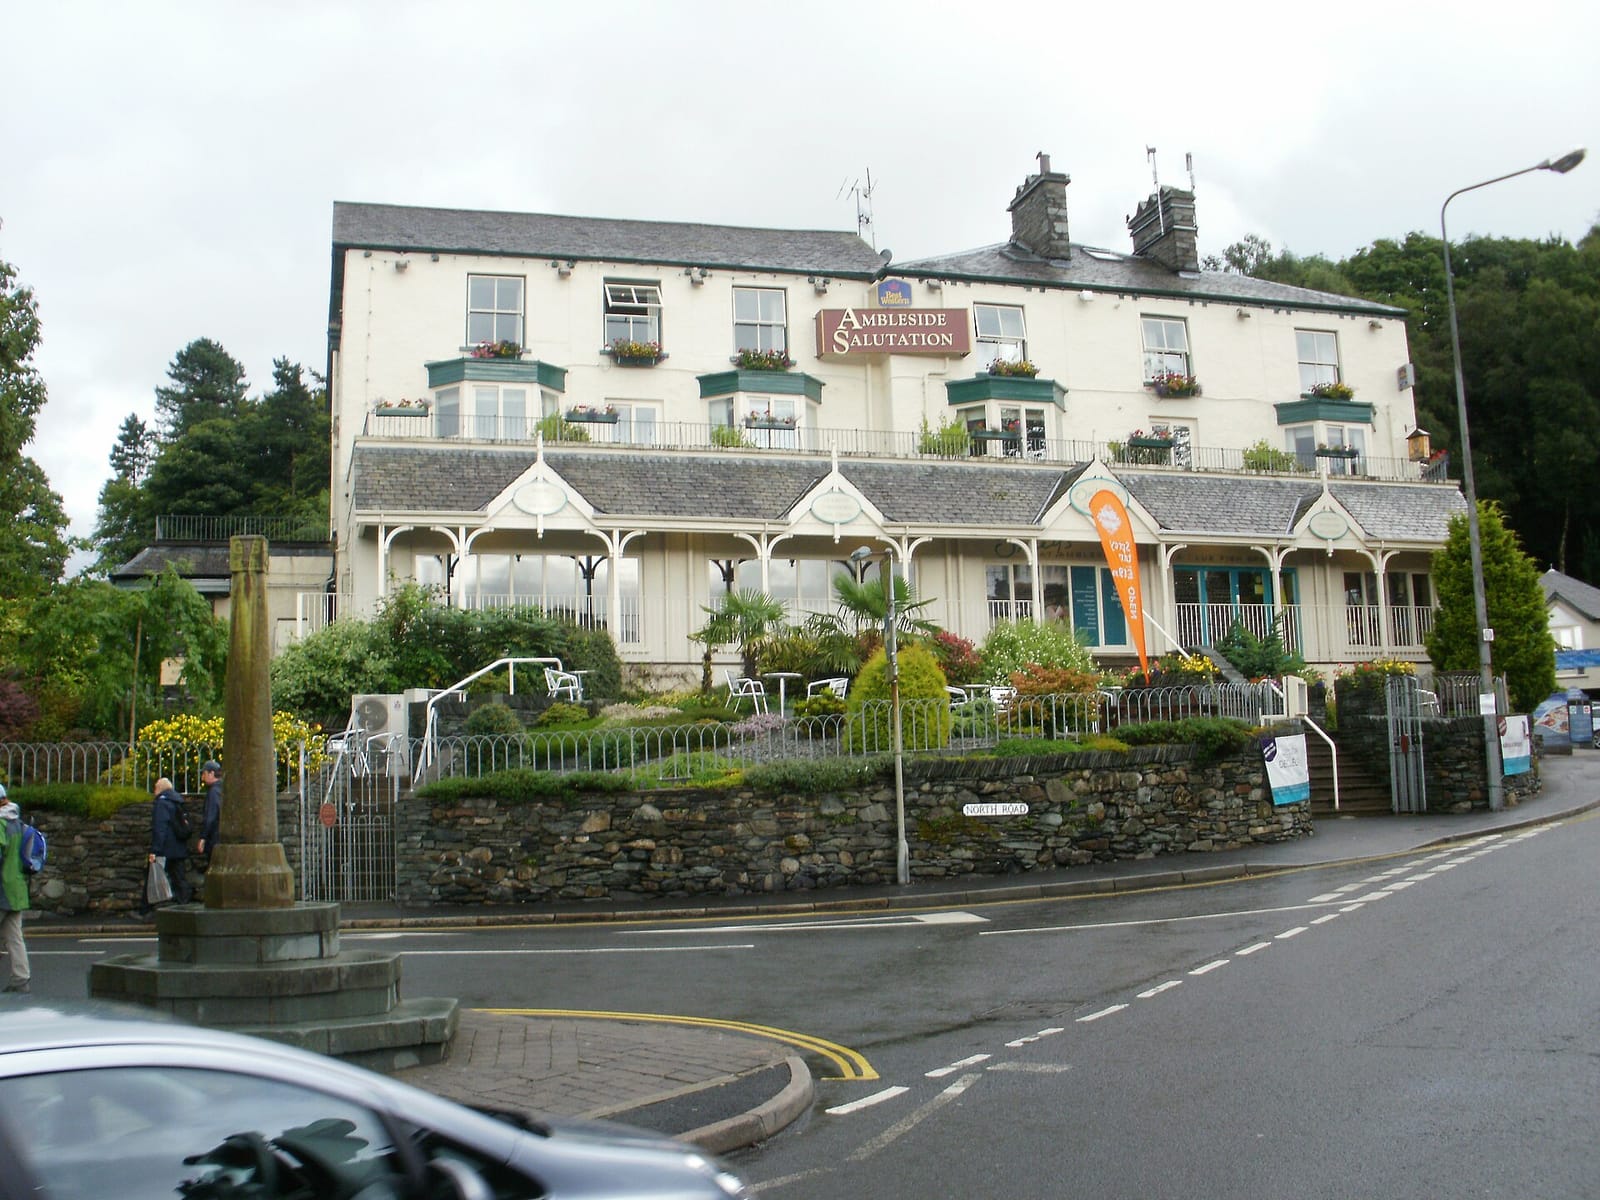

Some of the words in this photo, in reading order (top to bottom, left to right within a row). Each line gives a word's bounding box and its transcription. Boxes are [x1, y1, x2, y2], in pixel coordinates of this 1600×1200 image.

[886, 291, 902, 299] Best
[881, 297, 910, 305] Western
[837, 307, 946, 330] AMBLESIDE
[832, 330, 953, 354] SALUTATION
[966, 804, 998, 814] NORTH
[1002, 804, 1027, 814] ROAD
